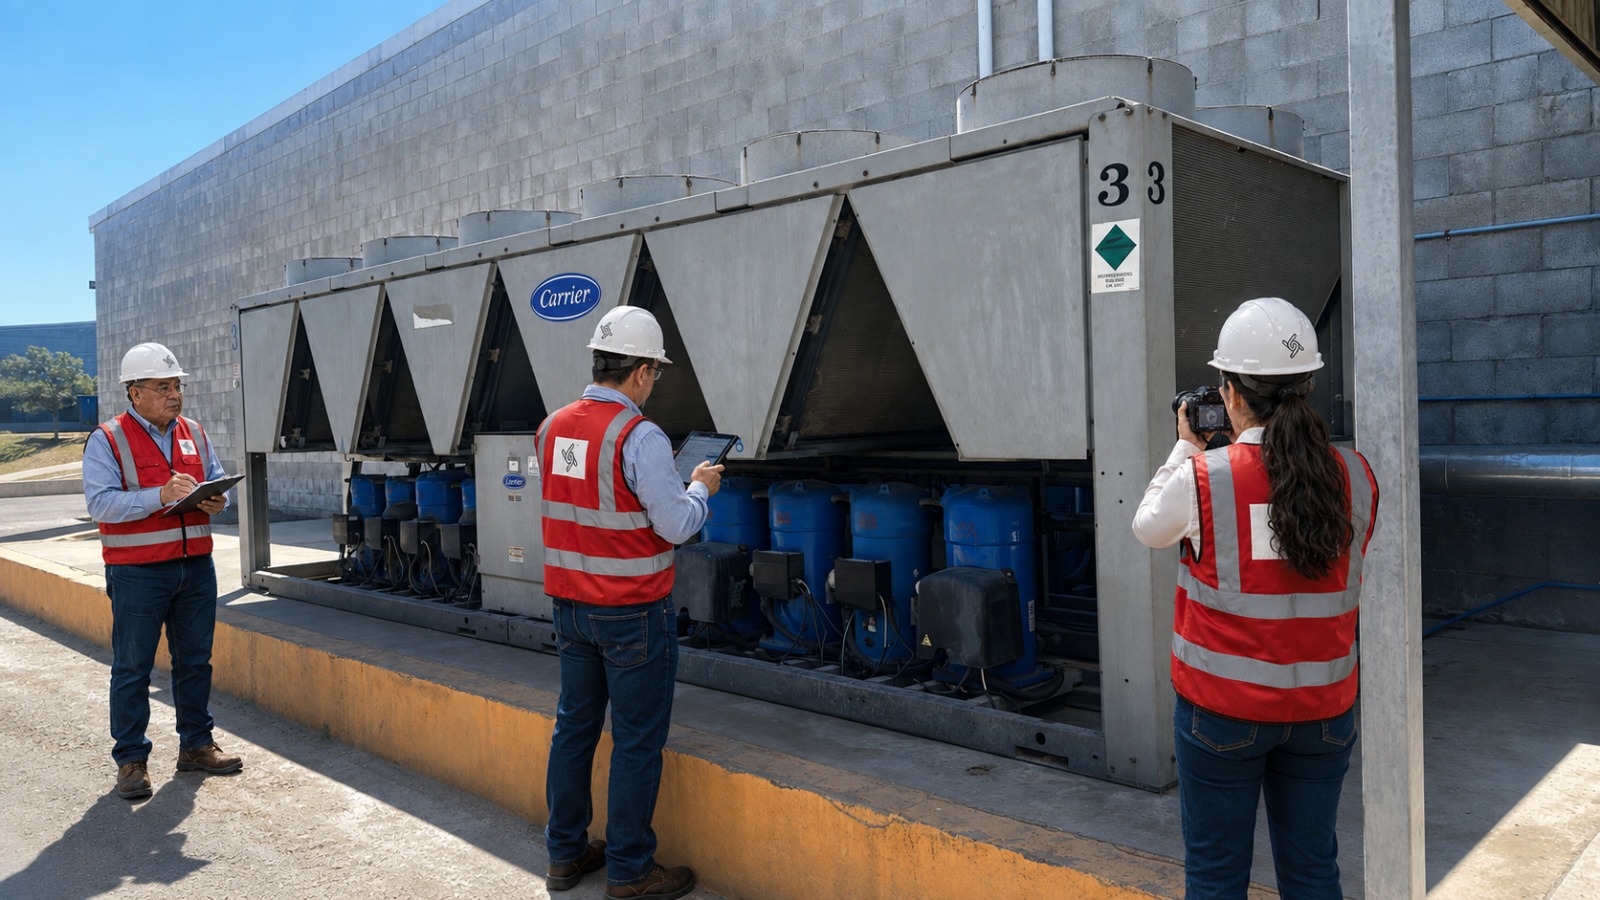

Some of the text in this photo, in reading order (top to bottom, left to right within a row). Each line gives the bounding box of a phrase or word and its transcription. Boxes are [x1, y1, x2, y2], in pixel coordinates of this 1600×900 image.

[1098, 163, 1129, 207] 3
[1148, 161, 1165, 205] 3
[540, 285, 591, 308] Carrier
[231, 324, 238, 350] 3
